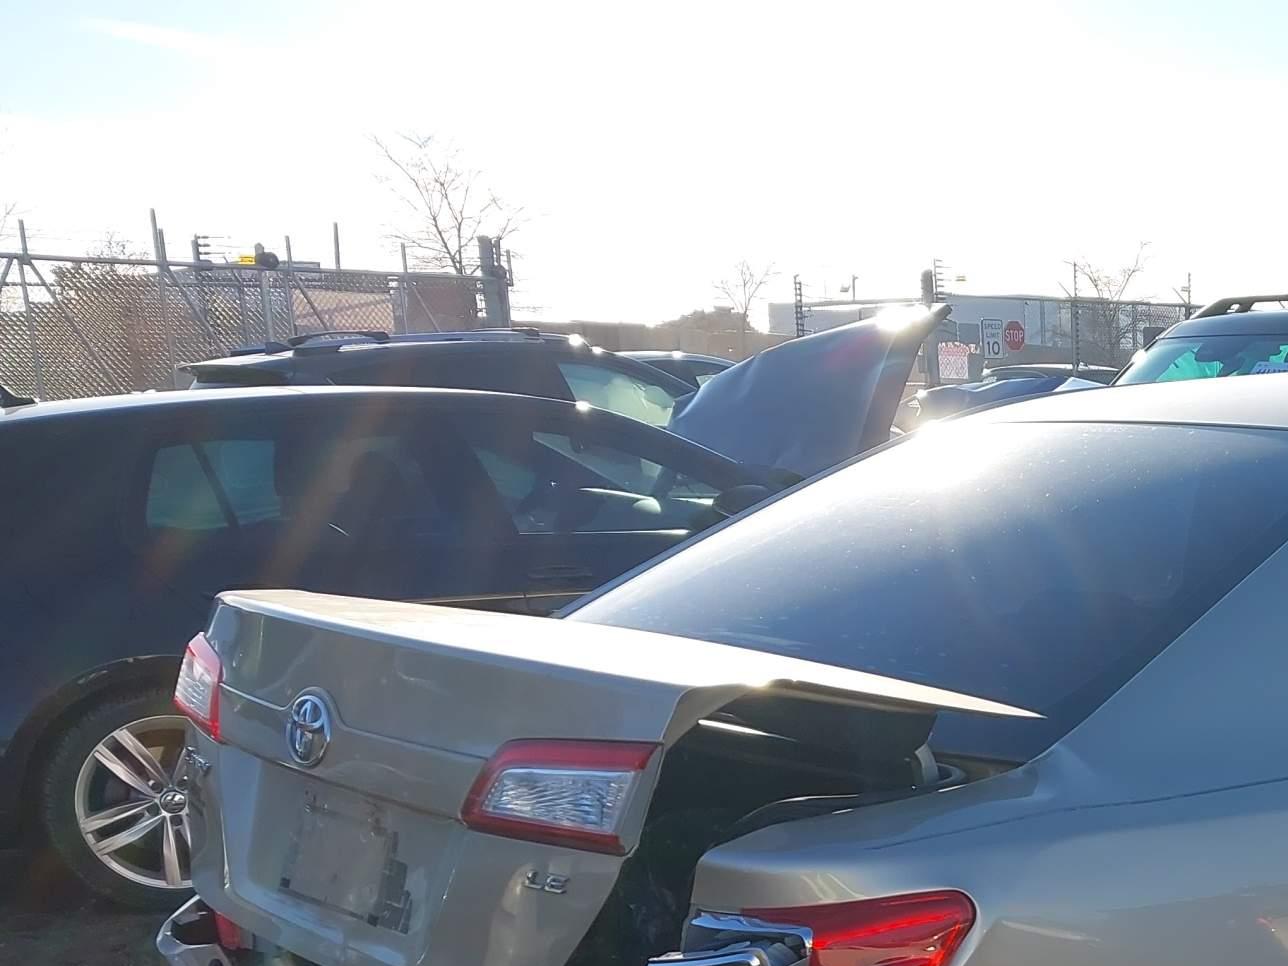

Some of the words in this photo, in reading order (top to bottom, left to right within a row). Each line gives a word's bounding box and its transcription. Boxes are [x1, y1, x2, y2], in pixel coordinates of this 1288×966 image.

[1005, 329, 1024, 342] STOP
[986, 340, 1001, 355] 10
[524, 869, 569, 895] LE
